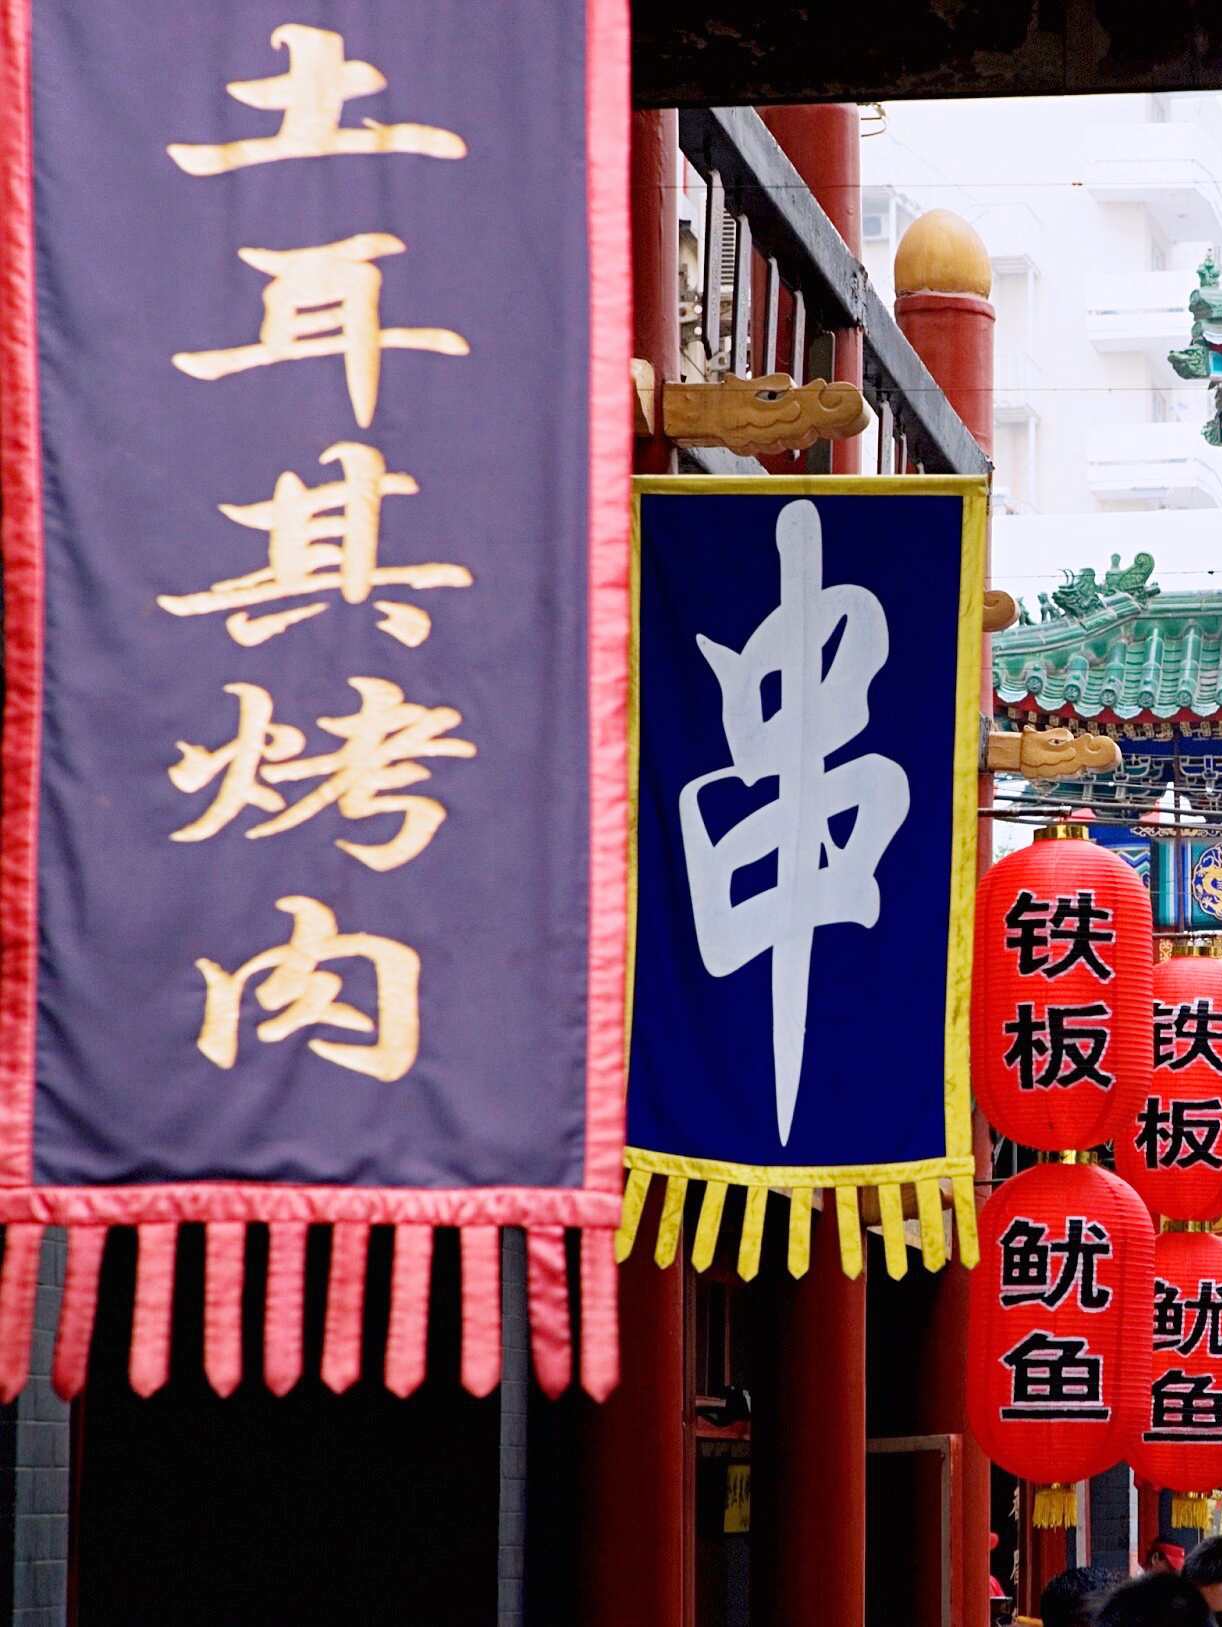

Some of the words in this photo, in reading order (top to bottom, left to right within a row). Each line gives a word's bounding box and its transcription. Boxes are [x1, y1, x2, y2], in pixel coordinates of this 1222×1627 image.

[156, 22, 478, 1084] 土耳其烤肉
[678, 497, 911, 1147] 串
[1003, 889, 1117, 1092] 铁板
[999, 1214, 1113, 1423] 鱿鱼
